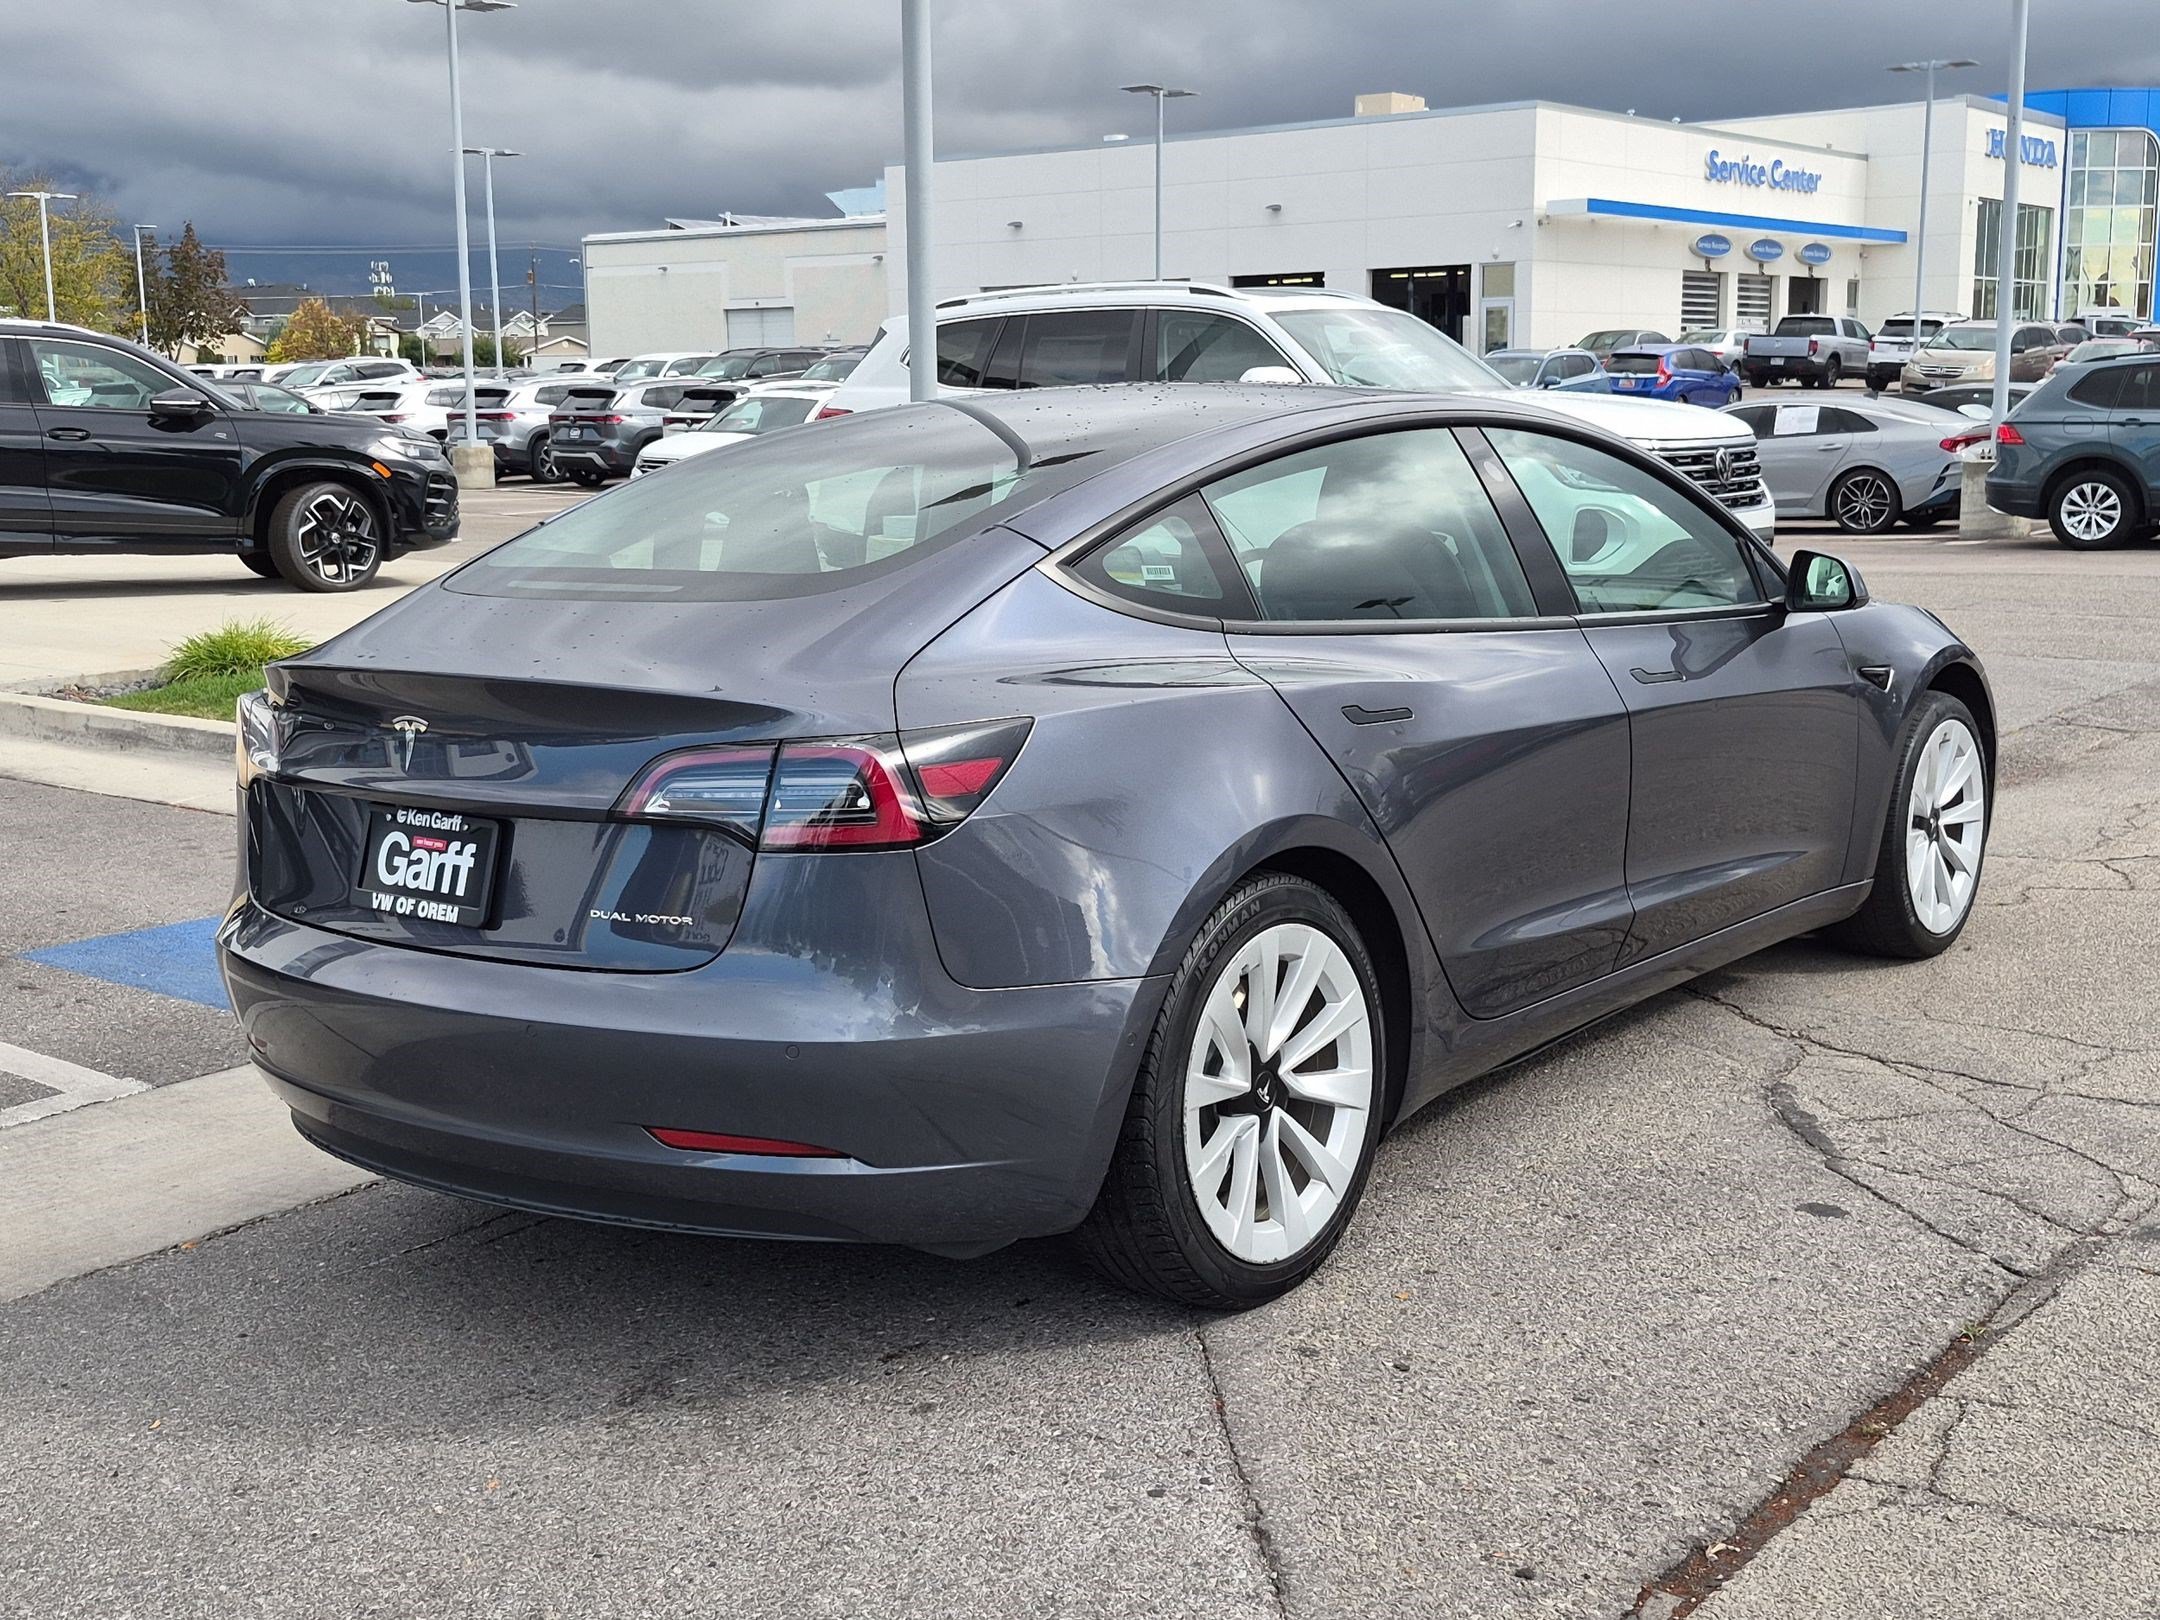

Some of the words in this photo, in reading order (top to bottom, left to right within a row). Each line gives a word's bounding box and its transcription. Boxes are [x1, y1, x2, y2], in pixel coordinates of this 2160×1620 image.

[1985, 128, 2058, 168] HNDA
[1704, 150, 1766, 187] Service
[1767, 159, 1822, 194] Center
[431, 811, 463, 832] Garff
[377, 831, 477, 897] Garff
[372, 892, 395, 912] VW
[396, 896, 416, 915] OF
[417, 899, 460, 923] OREM
[590, 909, 632, 922] DUAL
[635, 913, 694, 926] MOTOR
[1194, 900, 1262, 983] IRONMAN
